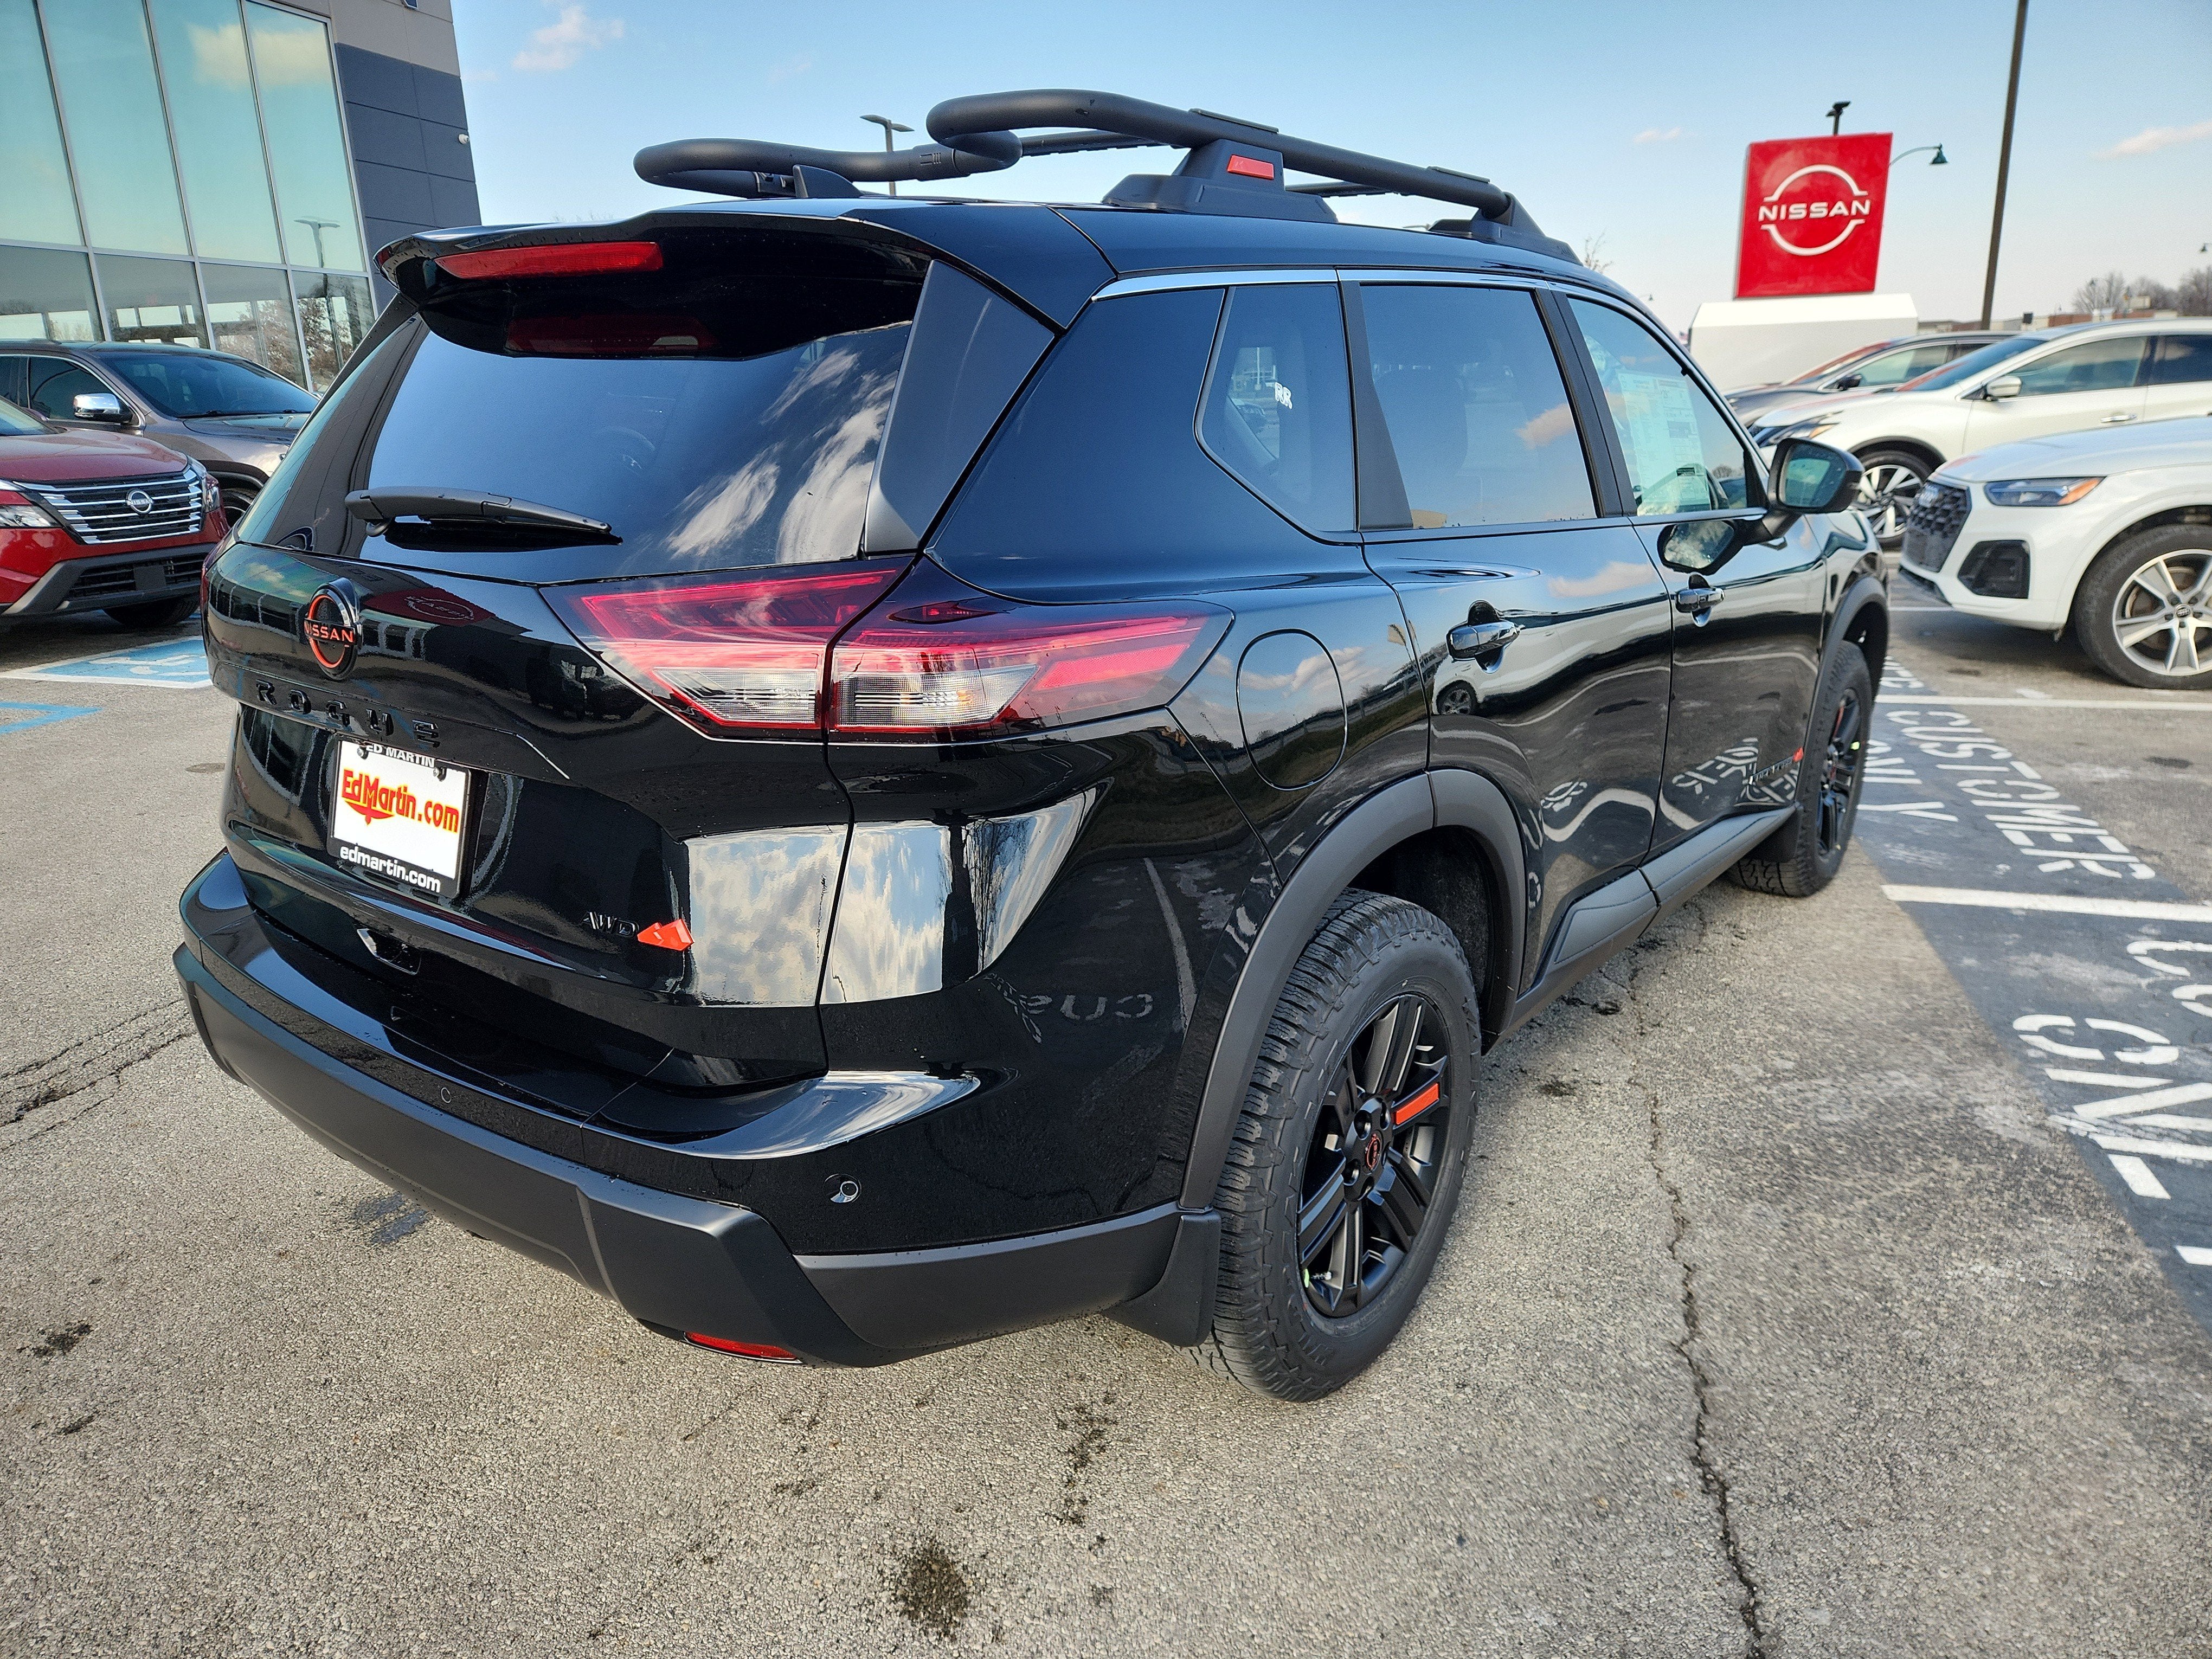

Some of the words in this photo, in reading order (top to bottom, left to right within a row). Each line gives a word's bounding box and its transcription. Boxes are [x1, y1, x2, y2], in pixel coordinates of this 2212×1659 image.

[1758, 198, 1871, 222] NISSAN
[304, 620, 353, 644] NISSAN
[255, 679, 440, 748] ROGUE
[366, 743, 383, 754] ED
[385, 747, 435, 768] MARTIN
[341, 768, 460, 834] EdMartin.com
[1886, 710, 2156, 879] CUSTOMER
[339, 845, 441, 893] edmartin.com
[580, 911, 640, 937] AWD
